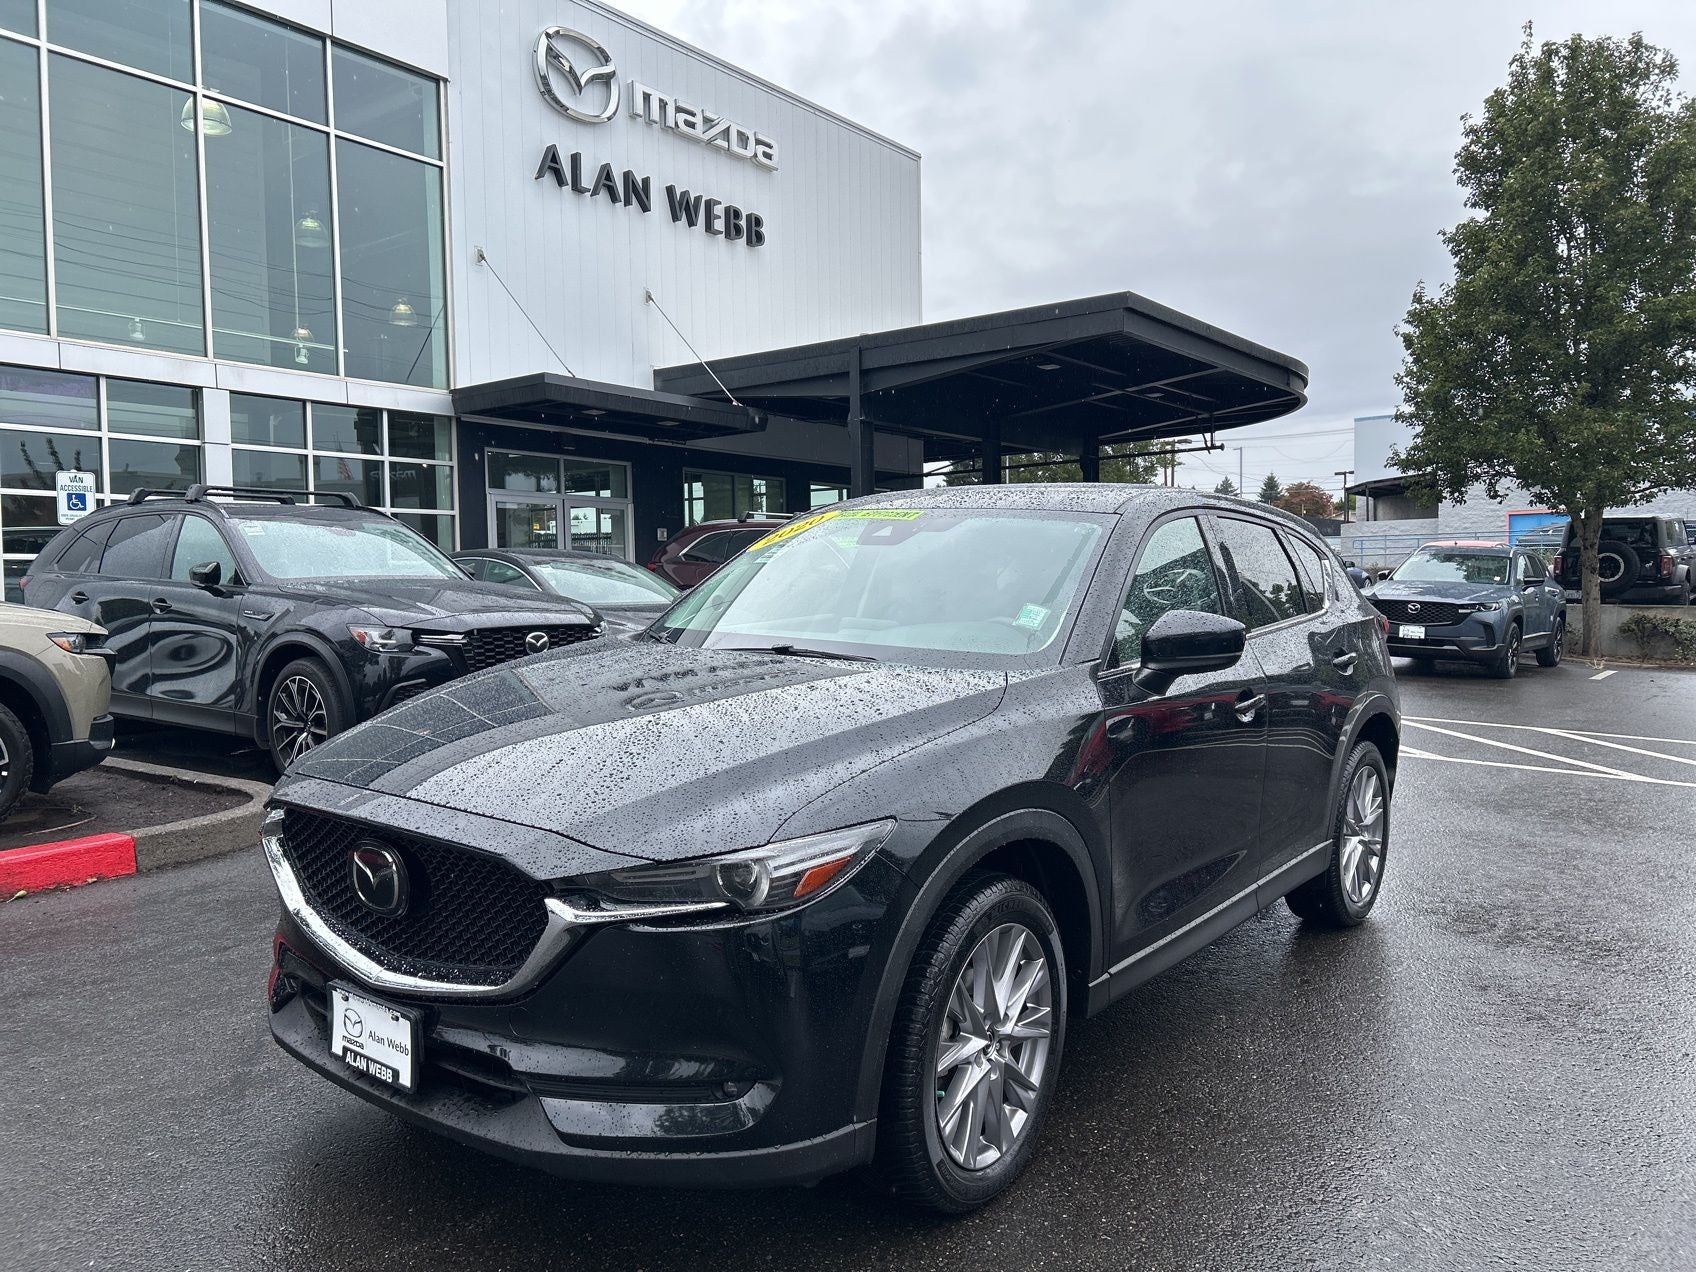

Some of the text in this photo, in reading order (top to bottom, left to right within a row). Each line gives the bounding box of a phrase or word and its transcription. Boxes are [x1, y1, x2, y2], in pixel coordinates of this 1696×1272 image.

[627, 79, 778, 172] mazda
[534, 143, 766, 248] ALAN WEBB
[69, 475, 83, 483] VAN
[762, 515, 825, 546] 2020
[342, 1035, 365, 1050] mazda
[368, 1030, 410, 1056] Alan Webb
[345, 1051, 393, 1082] ALAN WEBB
